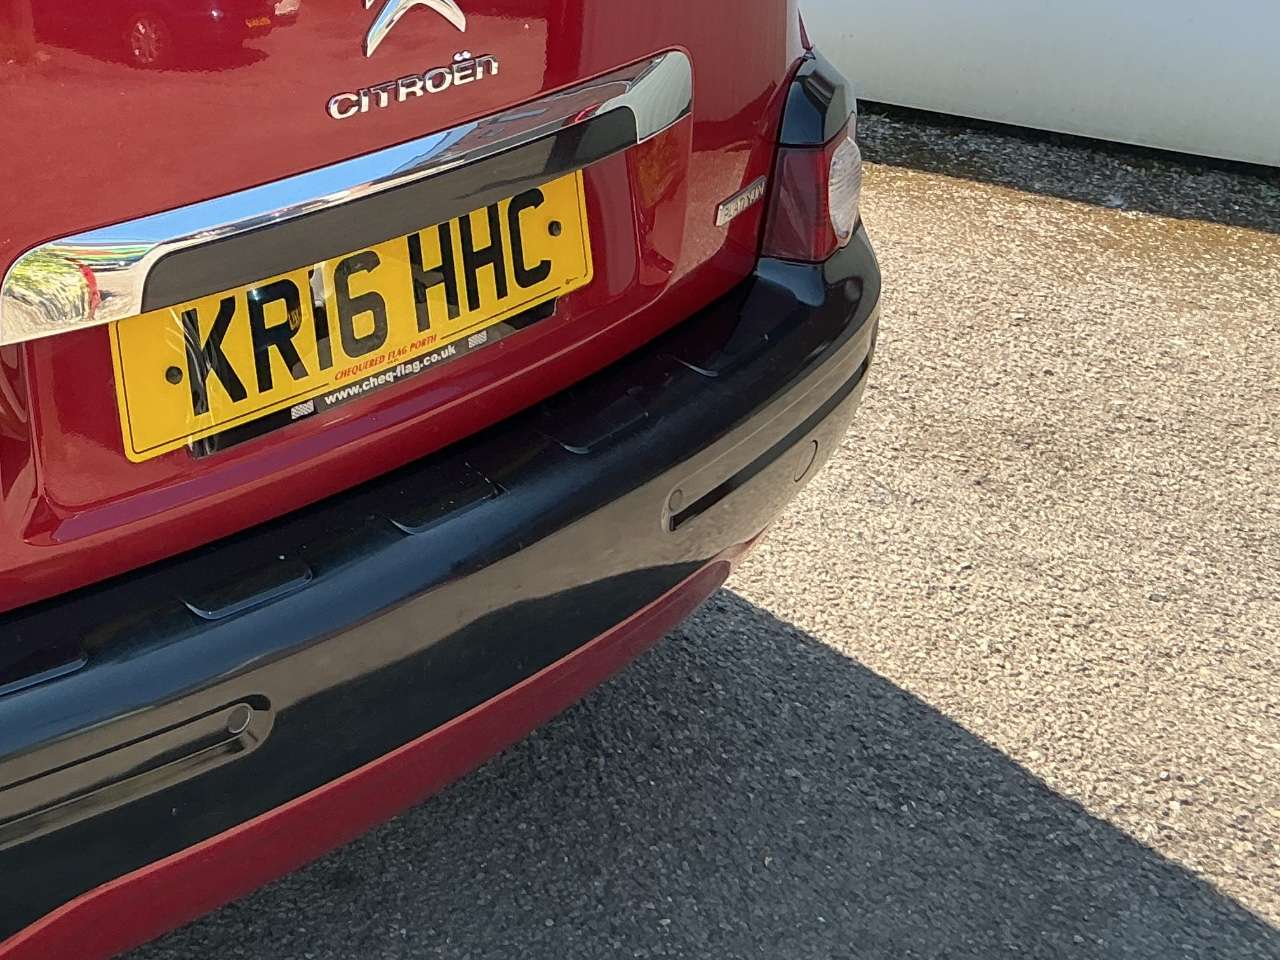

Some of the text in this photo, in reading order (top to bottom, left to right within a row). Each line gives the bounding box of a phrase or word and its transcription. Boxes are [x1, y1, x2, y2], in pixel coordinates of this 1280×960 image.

[325, 50, 499, 120] CITROËN
[181, 188, 552, 417] KR16 HHC
[324, 344, 457, 405] www.cheq-flag.co.uk
[334, 334, 438, 381] CHEQUERED FLAG PORTH
